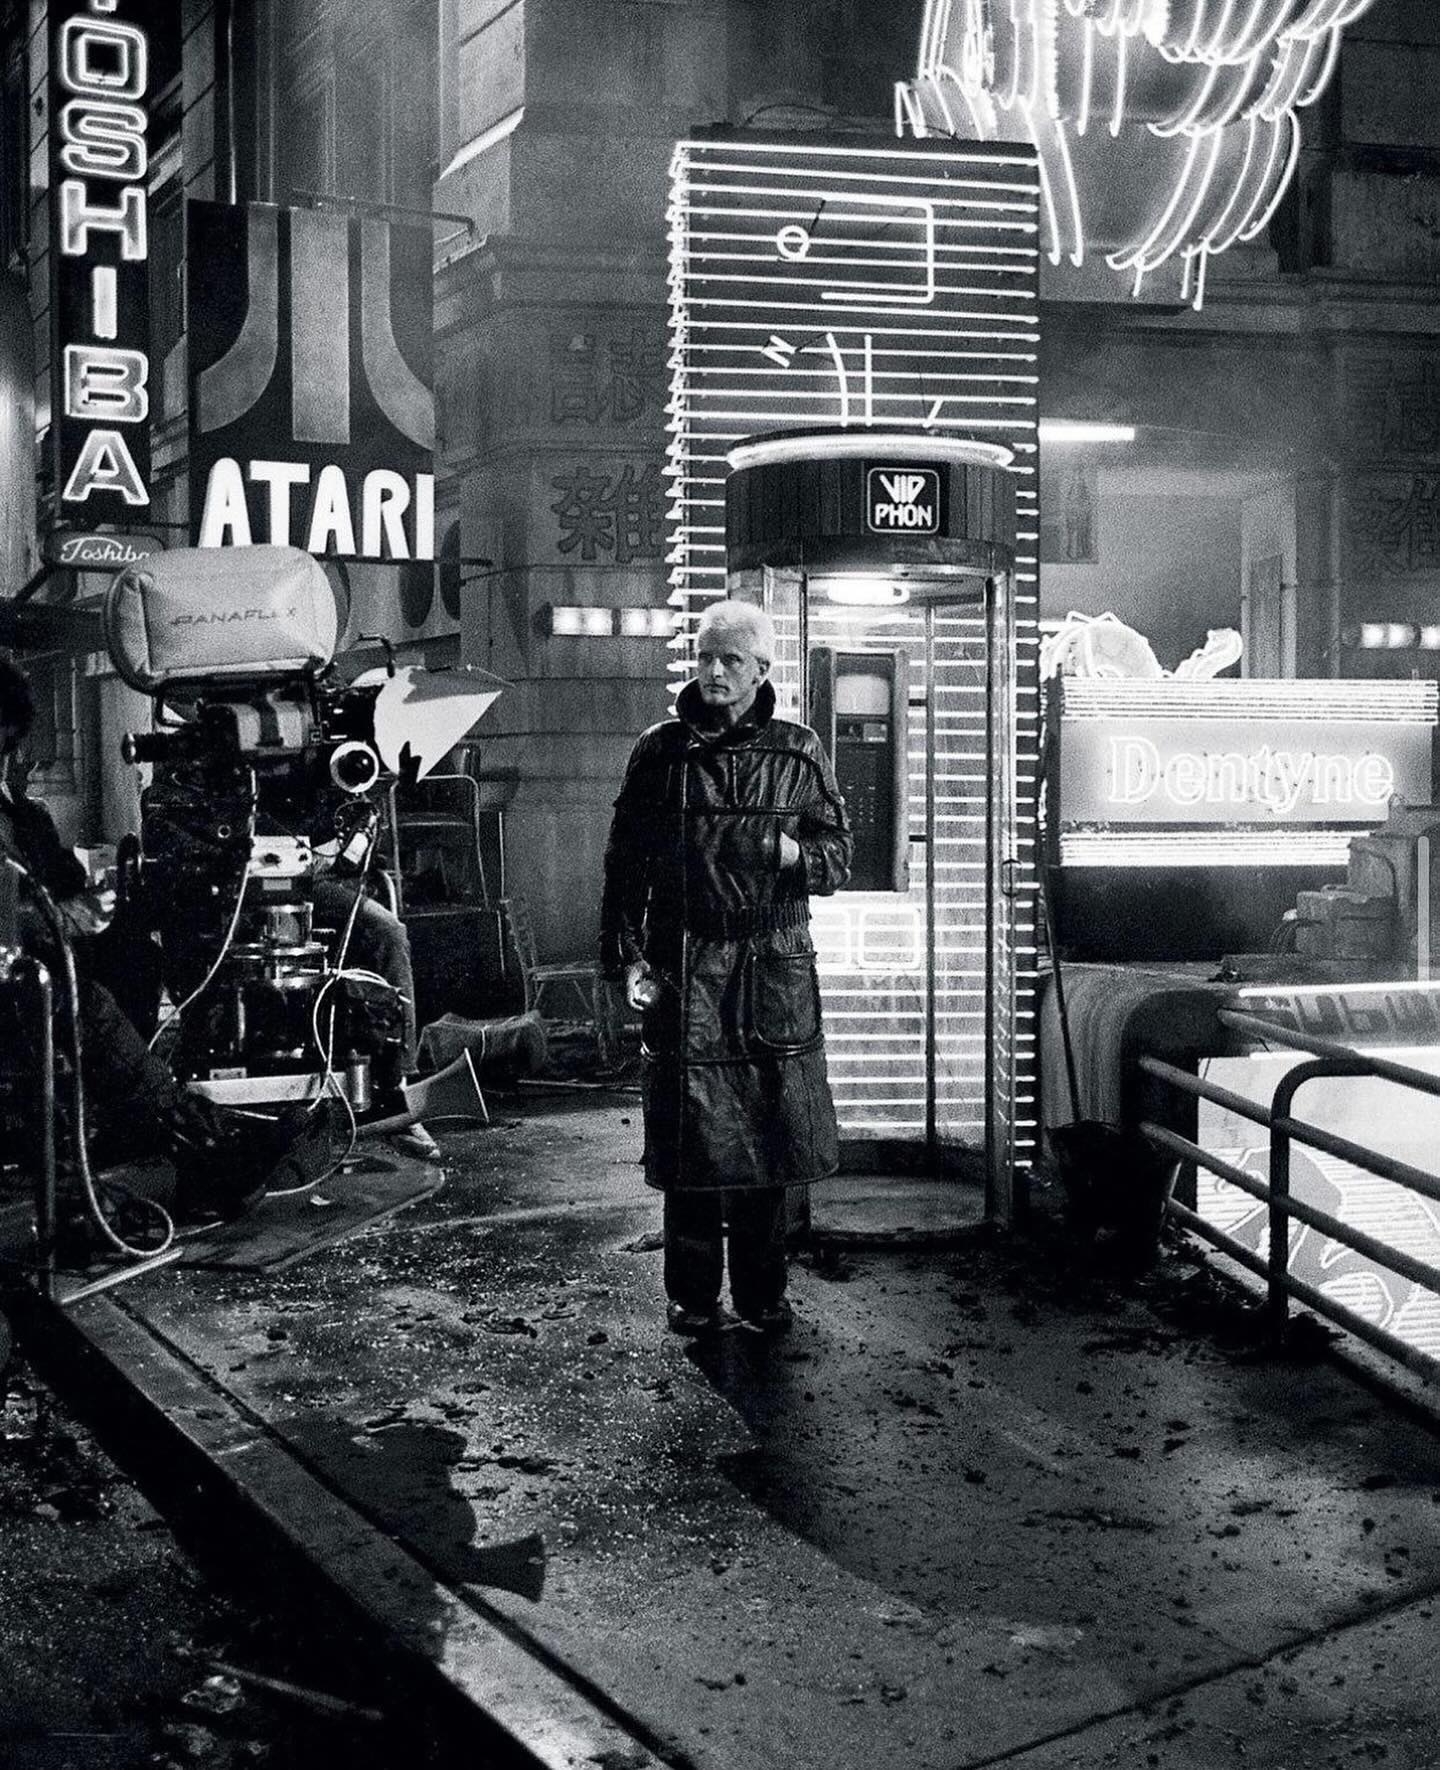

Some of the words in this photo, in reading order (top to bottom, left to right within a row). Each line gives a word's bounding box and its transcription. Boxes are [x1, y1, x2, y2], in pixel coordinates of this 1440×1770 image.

[62, 0, 150, 505] OSHIBA
[201, 457, 435, 561] ATARI
[875, 503, 932, 527] PHON
[170, 608, 297, 626] PANAFLX
[1107, 735, 1395, 813] Dentyne
